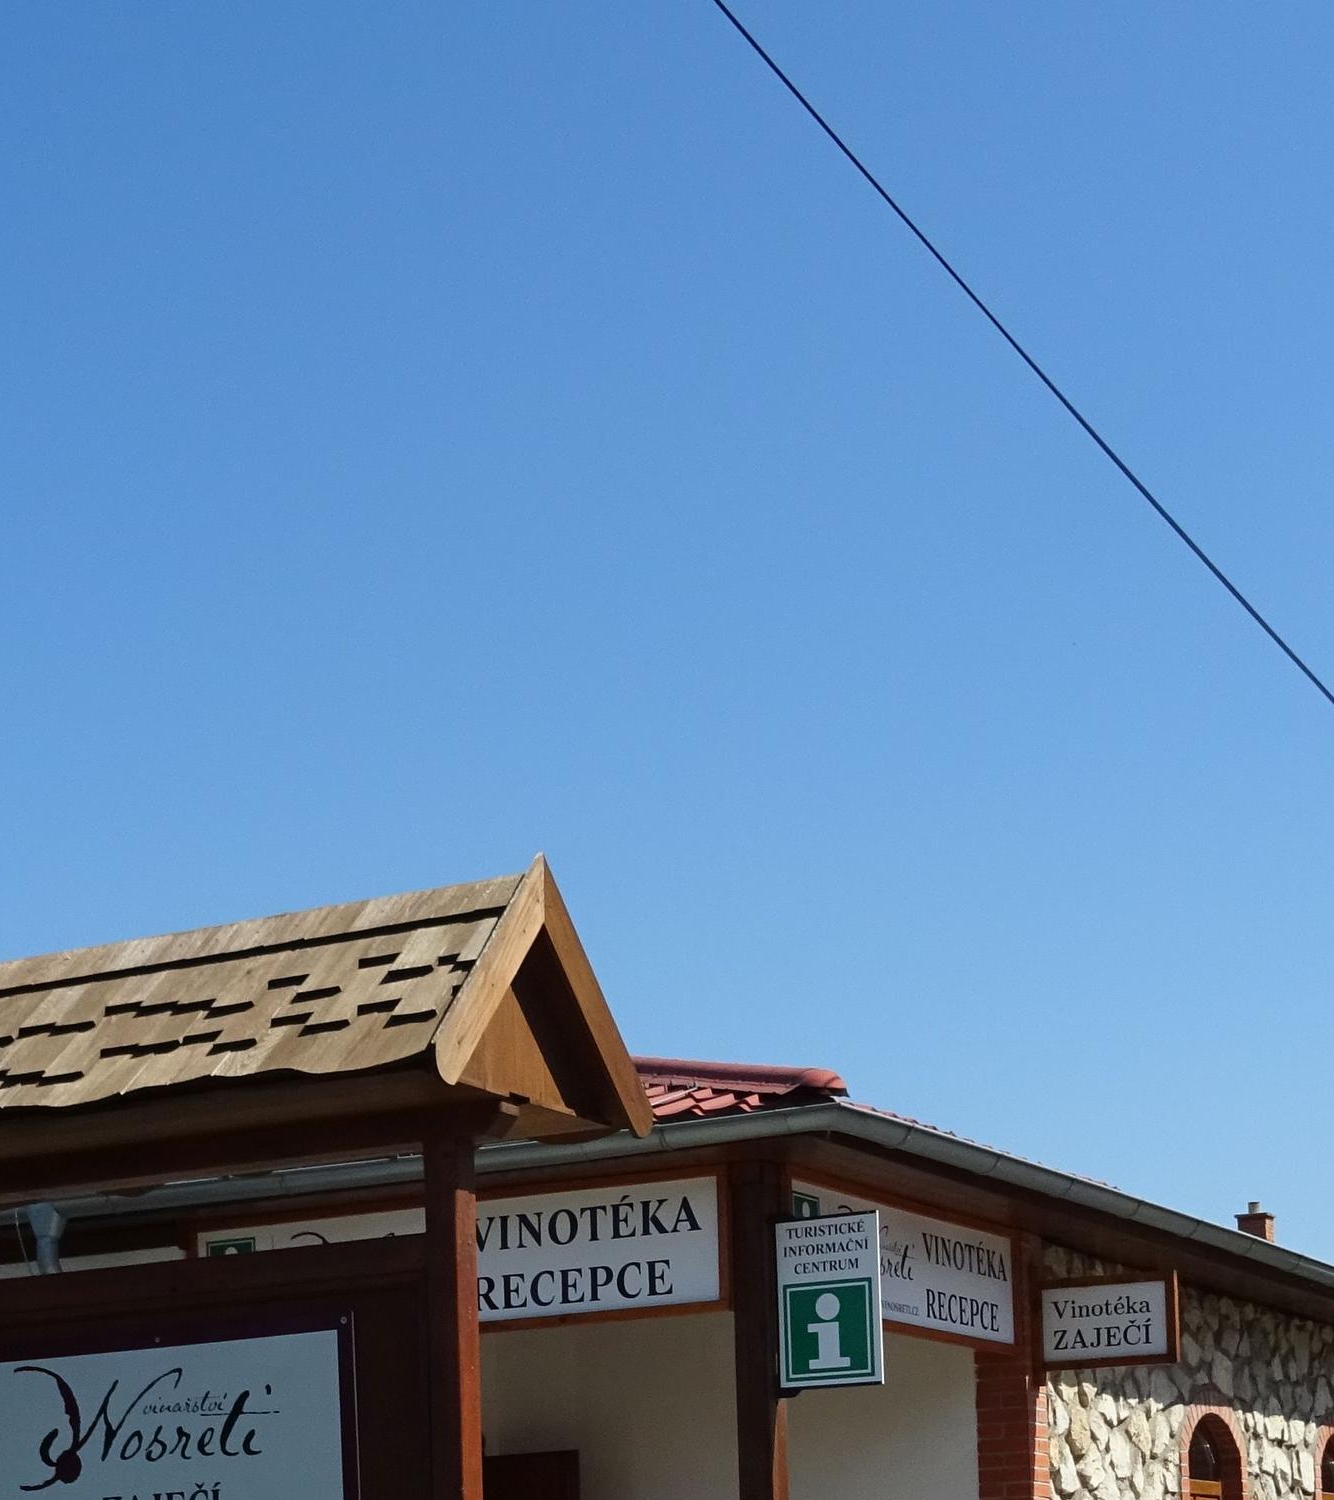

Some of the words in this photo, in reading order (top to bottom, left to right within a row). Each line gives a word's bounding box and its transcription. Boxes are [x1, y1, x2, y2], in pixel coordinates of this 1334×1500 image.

[475, 1194, 702, 1253] VINOTÉKA
[785, 1220, 866, 1240] TURISTICKÉ
[783, 1236, 869, 1258] INFORMAČNÍ
[922, 1232, 1008, 1282] VINOTÉKA
[794, 1257, 860, 1275] CENTRUM
[477, 1259, 674, 1312] RECEPCE
[926, 1288, 1000, 1333] RECEPCE
[1051, 1295, 1152, 1320] Vinotéka
[1053, 1318, 1153, 1351] ZAJEČÍ
